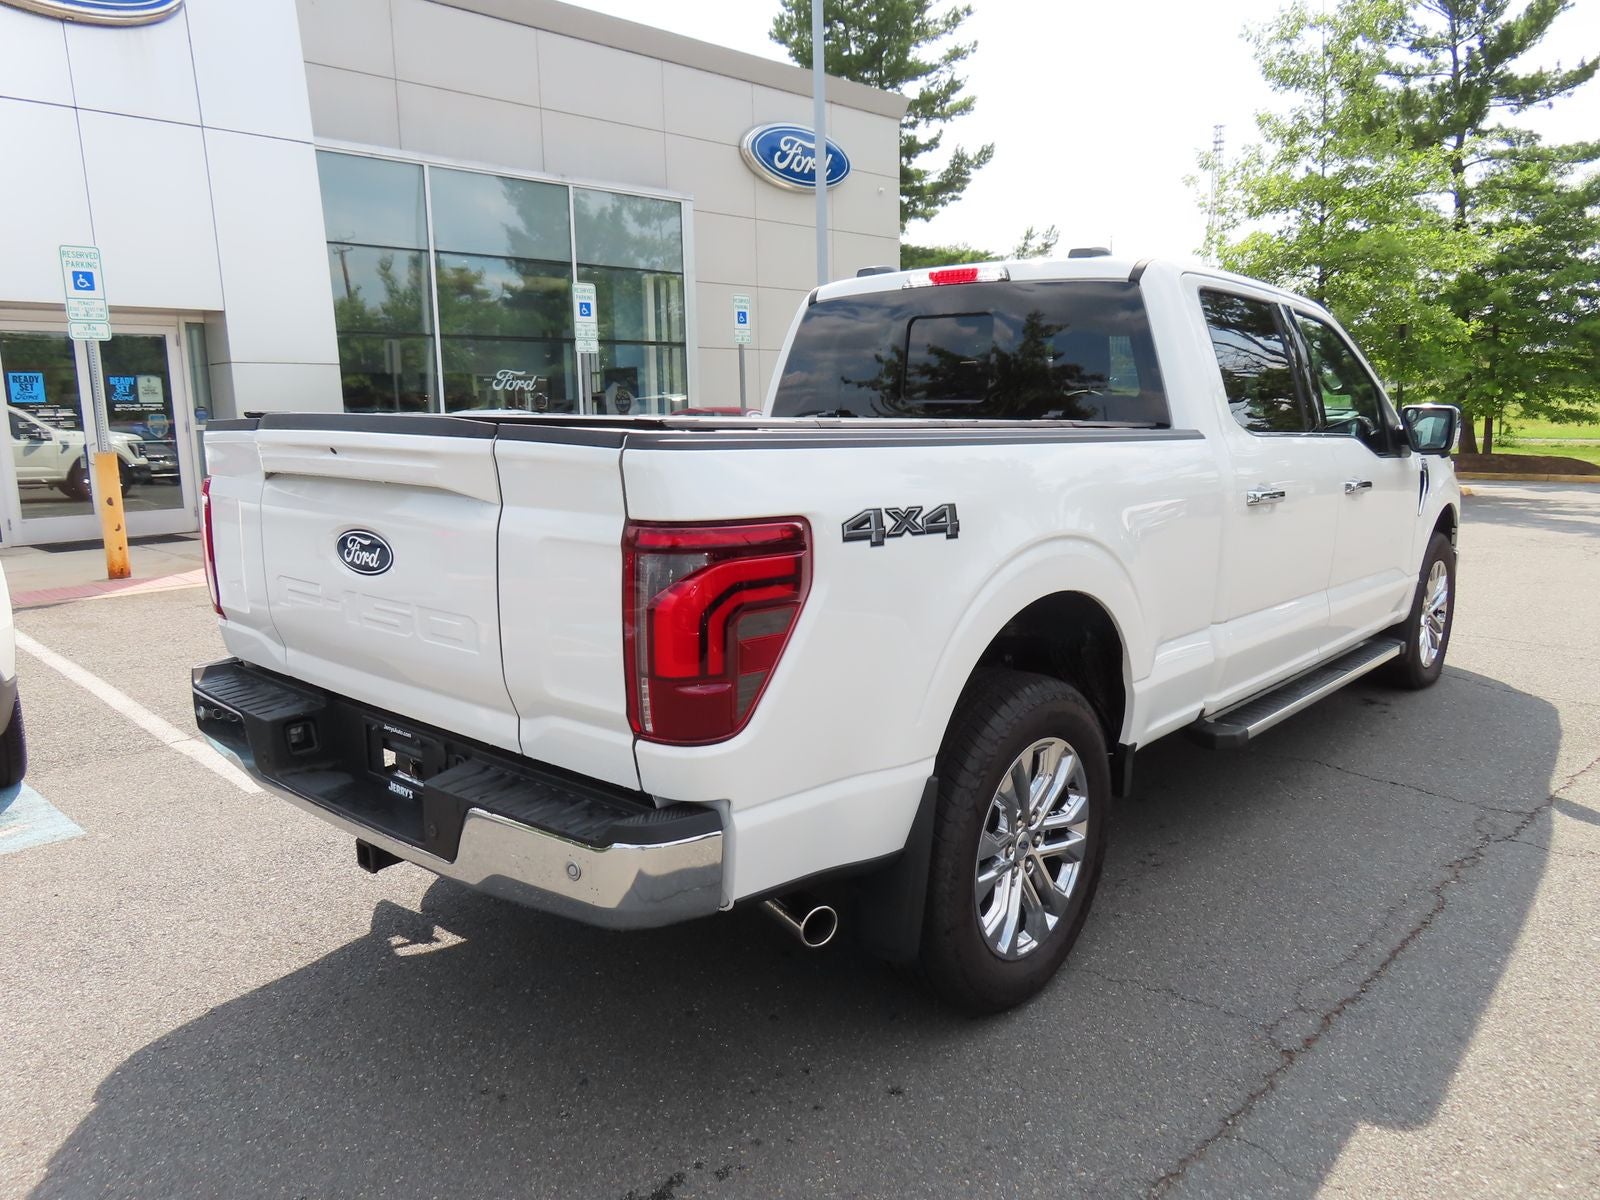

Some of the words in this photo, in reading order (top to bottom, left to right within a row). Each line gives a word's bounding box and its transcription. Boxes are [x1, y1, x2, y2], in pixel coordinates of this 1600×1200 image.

[61, 250, 98, 260] RESERVED
[65, 260, 97, 269] PARKING
[12, 375, 39, 384] READY
[109, 377, 135, 386] READY
[492, 370, 537, 391] Ford
[19, 383, 34, 392] SET
[115, 384, 130, 393] SET
[14, 392, 39, 400] Ford
[111, 392, 136, 401] Ford
[842, 503, 960, 547] 4X4
[344, 535, 380, 568] Ford
